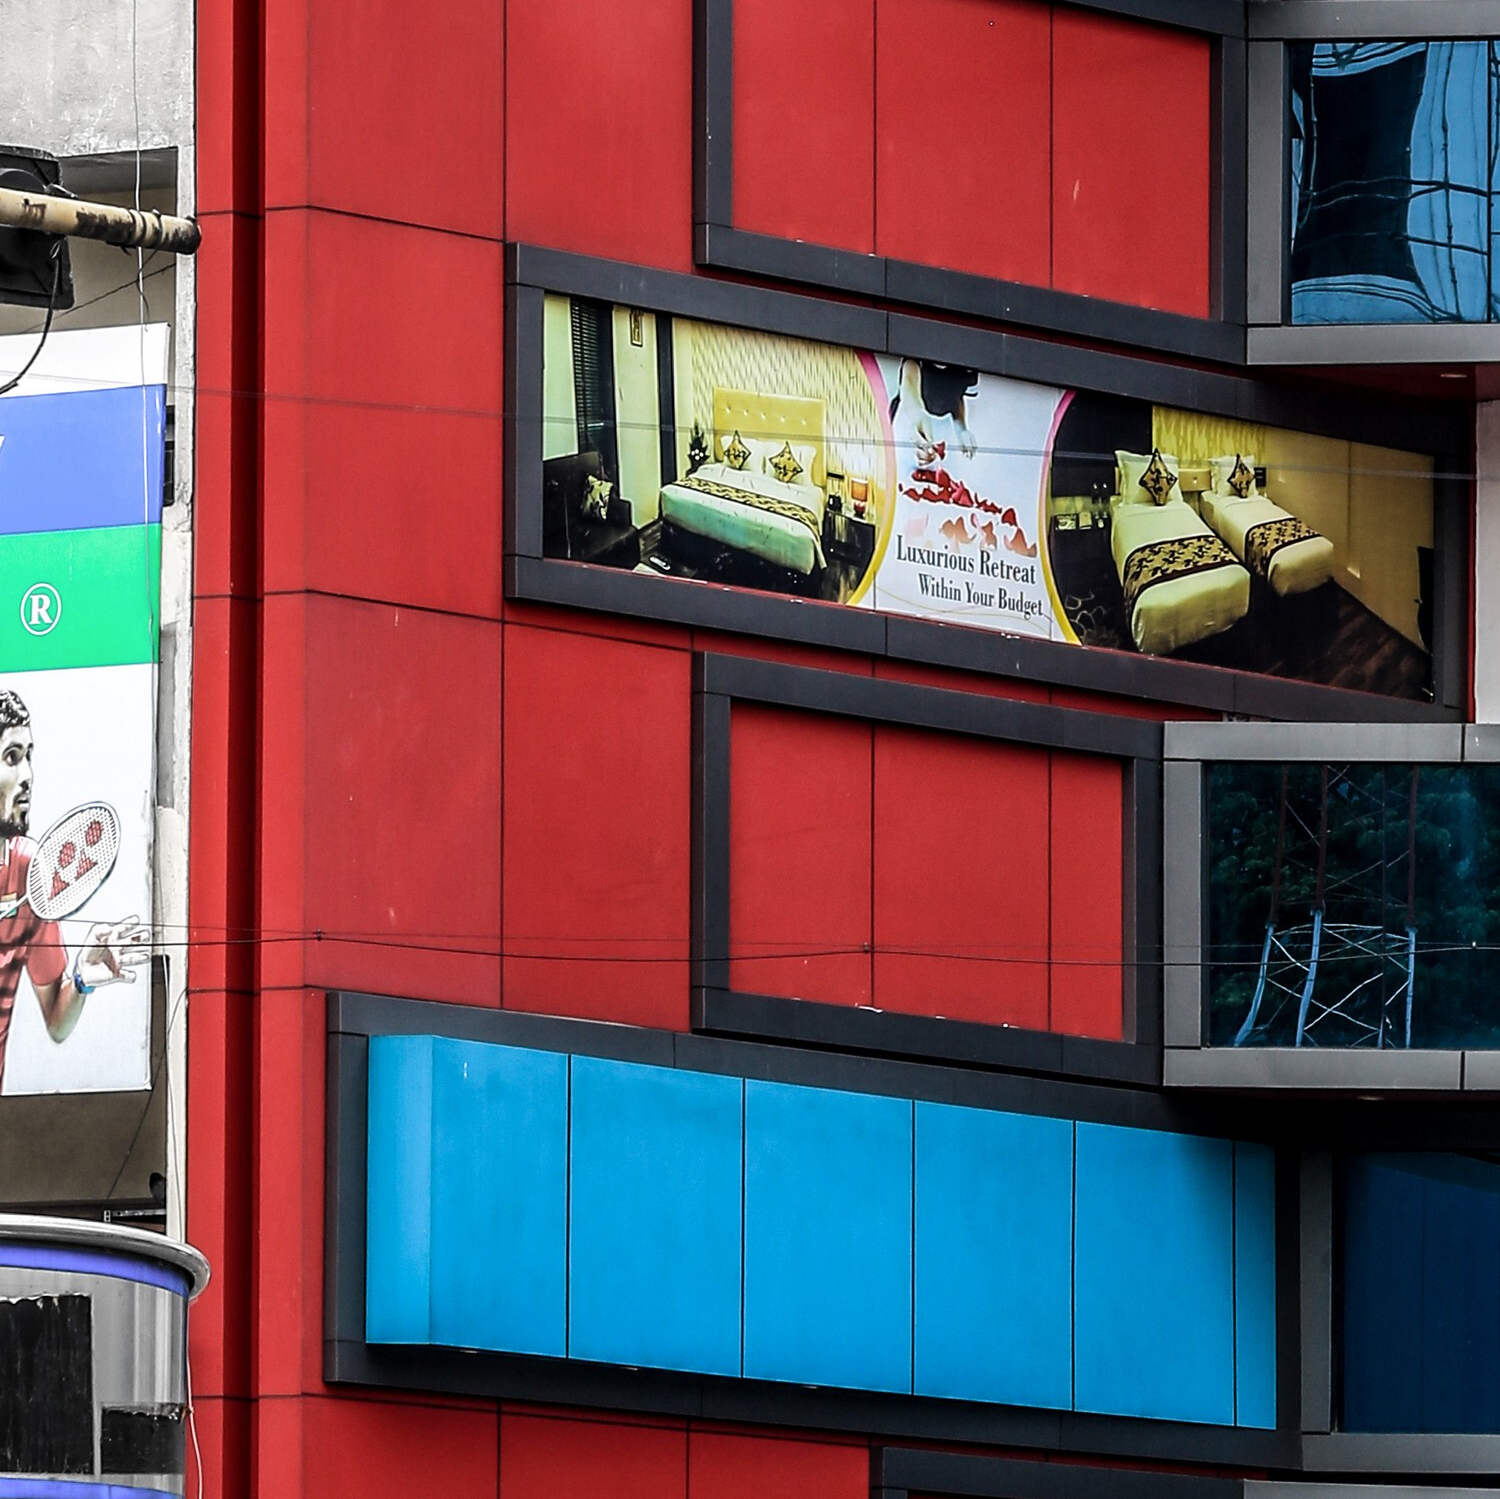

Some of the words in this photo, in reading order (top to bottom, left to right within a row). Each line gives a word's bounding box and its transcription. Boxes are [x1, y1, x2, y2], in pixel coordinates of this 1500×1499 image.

[896, 535, 974, 573] Luxurious
[980, 550, 1036, 585] Retreat
[918, 573, 961, 601] Within
[965, 582, 995, 608] Your
[998, 587, 1044, 619] Budget
